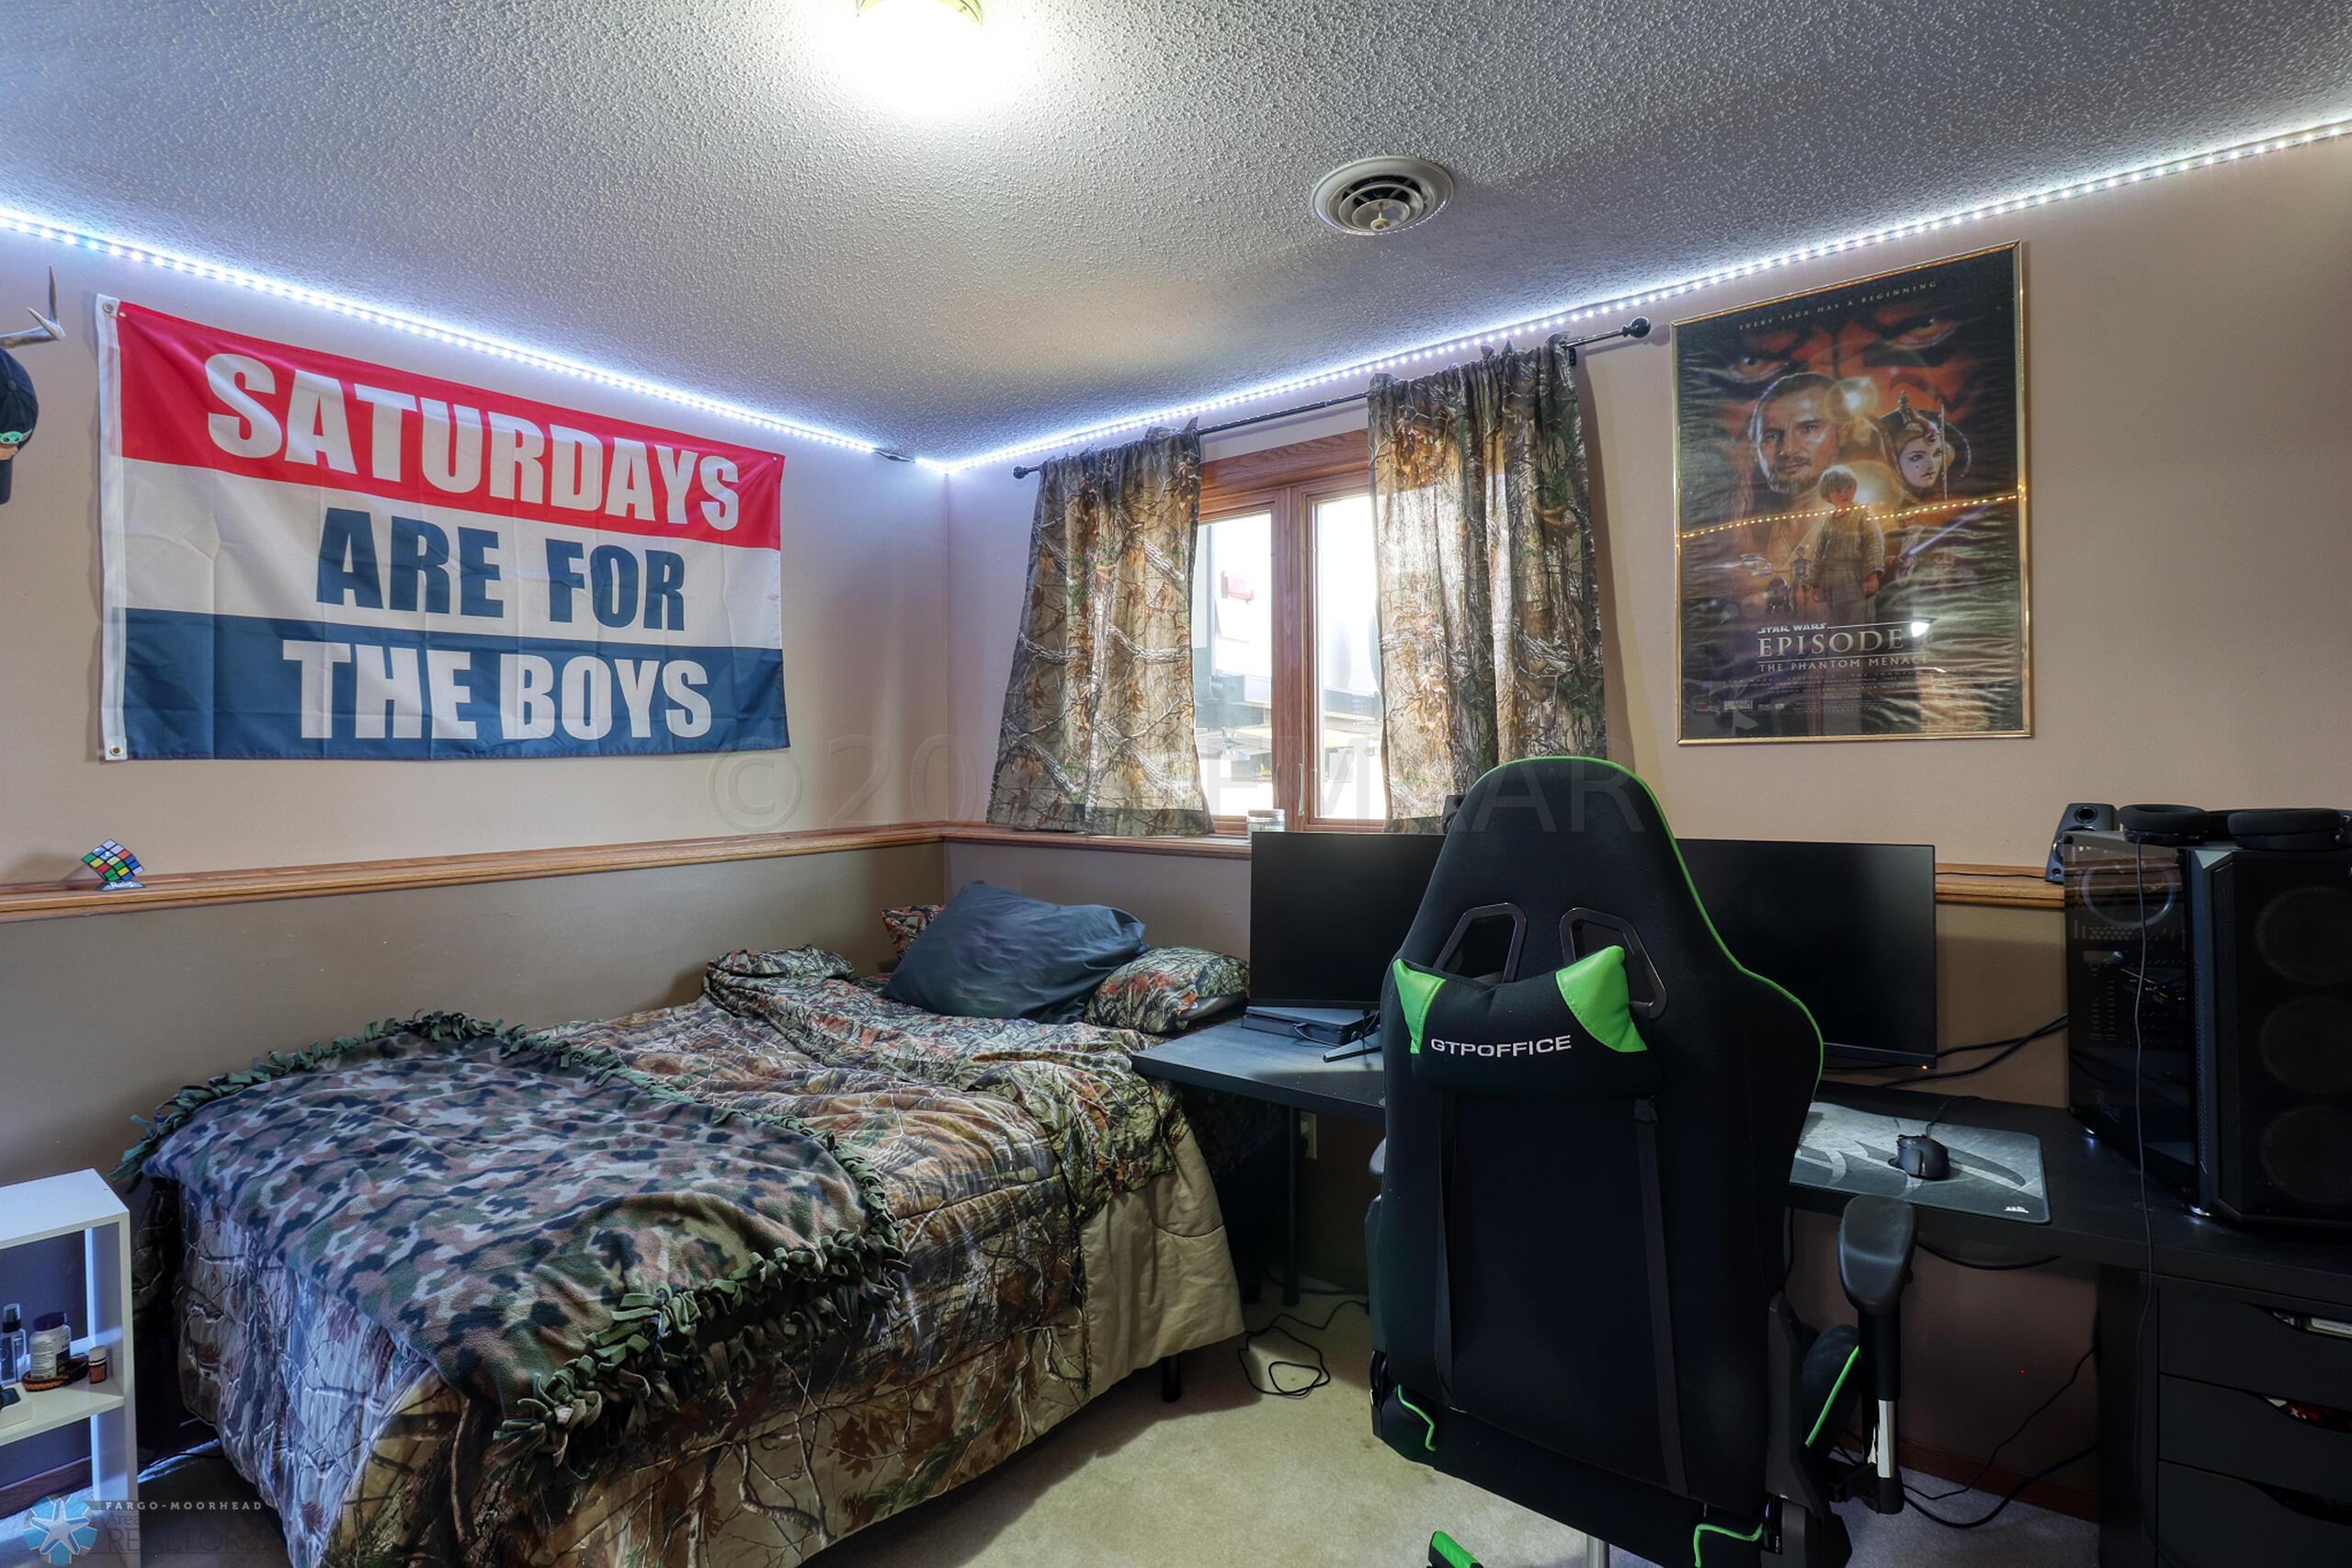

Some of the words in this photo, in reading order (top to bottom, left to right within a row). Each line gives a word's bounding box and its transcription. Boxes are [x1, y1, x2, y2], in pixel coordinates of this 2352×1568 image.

[1739, 317, 1774, 331] EVERY
[1780, 310, 1810, 322] SAGA
[1816, 302, 1840, 313] HAS
[1860, 280, 1937, 304] BEGINNING
[204, 353, 740, 532] SATURDAYS
[316, 506, 504, 619] ARE
[545, 538, 686, 631] FOR
[1756, 626, 1791, 634] STAR
[1792, 622, 1828, 632] WARS
[1757, 628, 1904, 658] EPISODE
[1758, 663, 1784, 673] THE
[1790, 658, 1861, 671] PHANTOM
[1868, 654, 1928, 667] MENACE
[283, 640, 479, 741] THE
[499, 653, 712, 741] BOYS
[1430, 1034, 1573, 1058] GTPOFFICE
